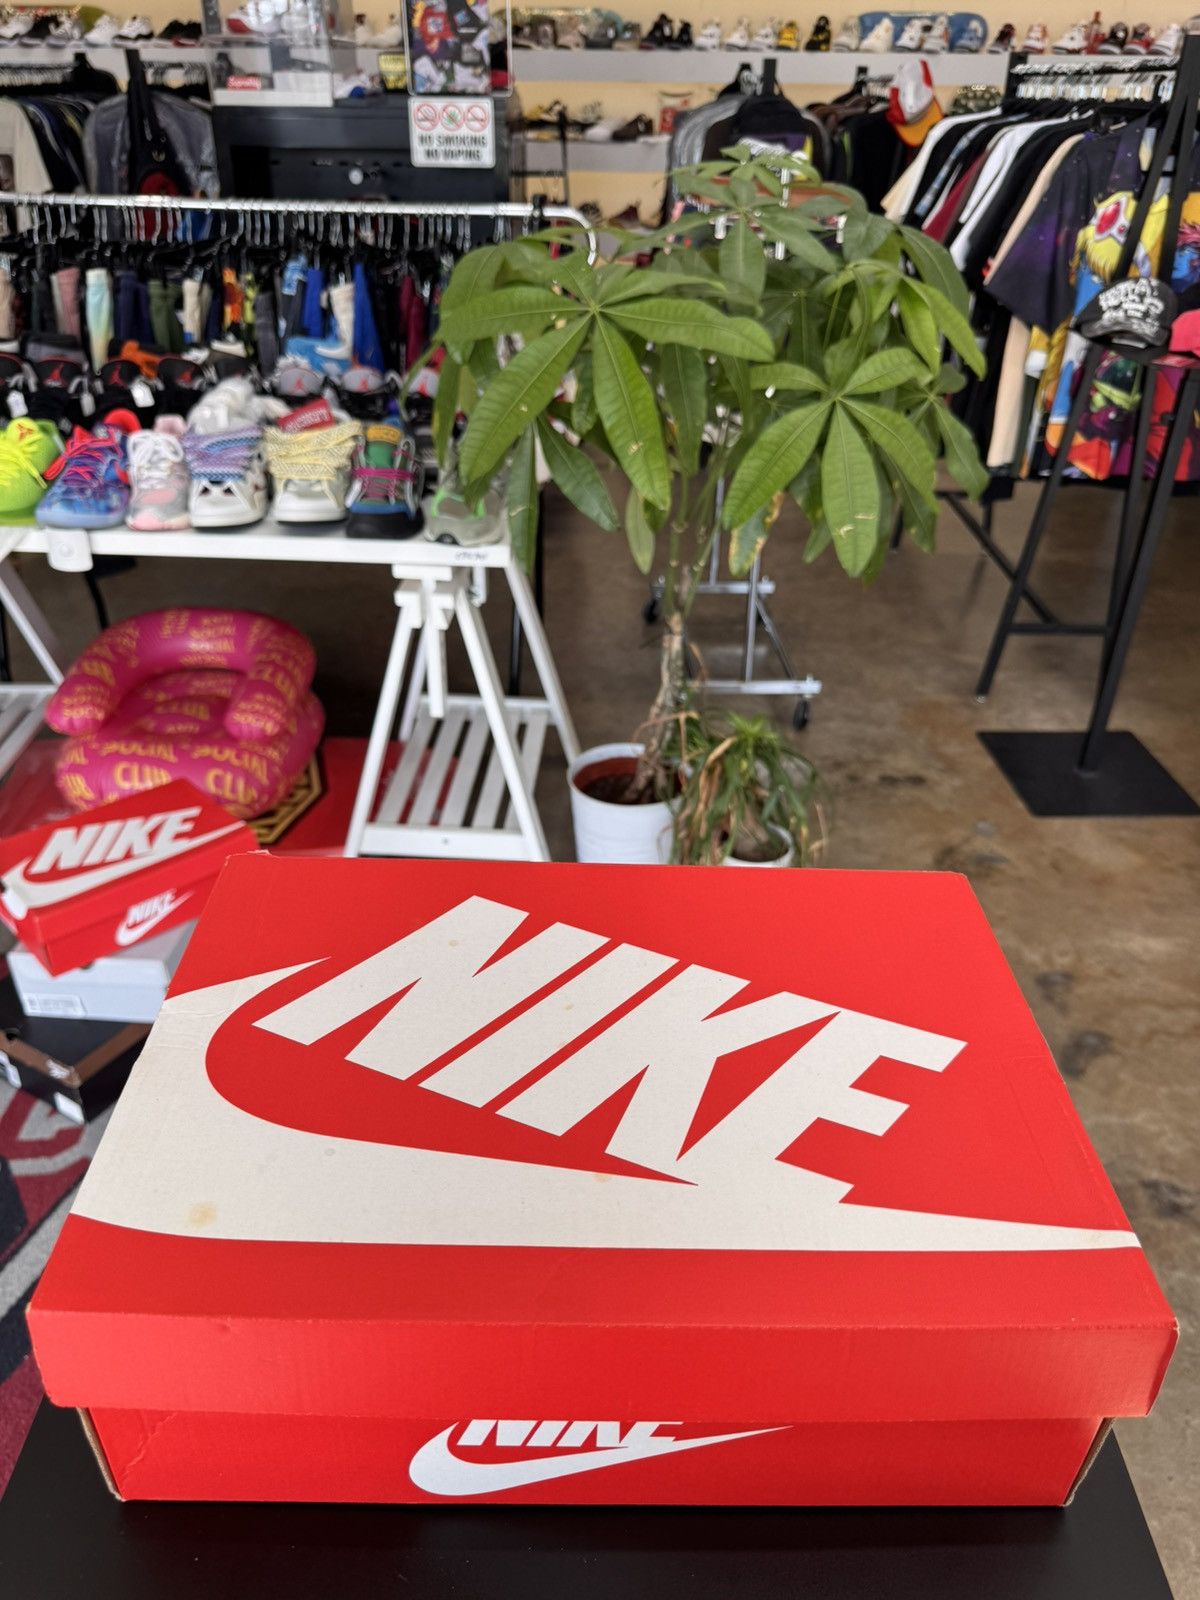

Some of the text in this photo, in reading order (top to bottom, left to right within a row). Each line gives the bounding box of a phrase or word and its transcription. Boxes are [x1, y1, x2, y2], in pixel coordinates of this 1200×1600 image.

[437, 135, 487, 147] SMOKING
[29, 806, 202, 875] NIKE
[127, 889, 177, 928] NIKE
[251, 895, 967, 1203] NIKE
